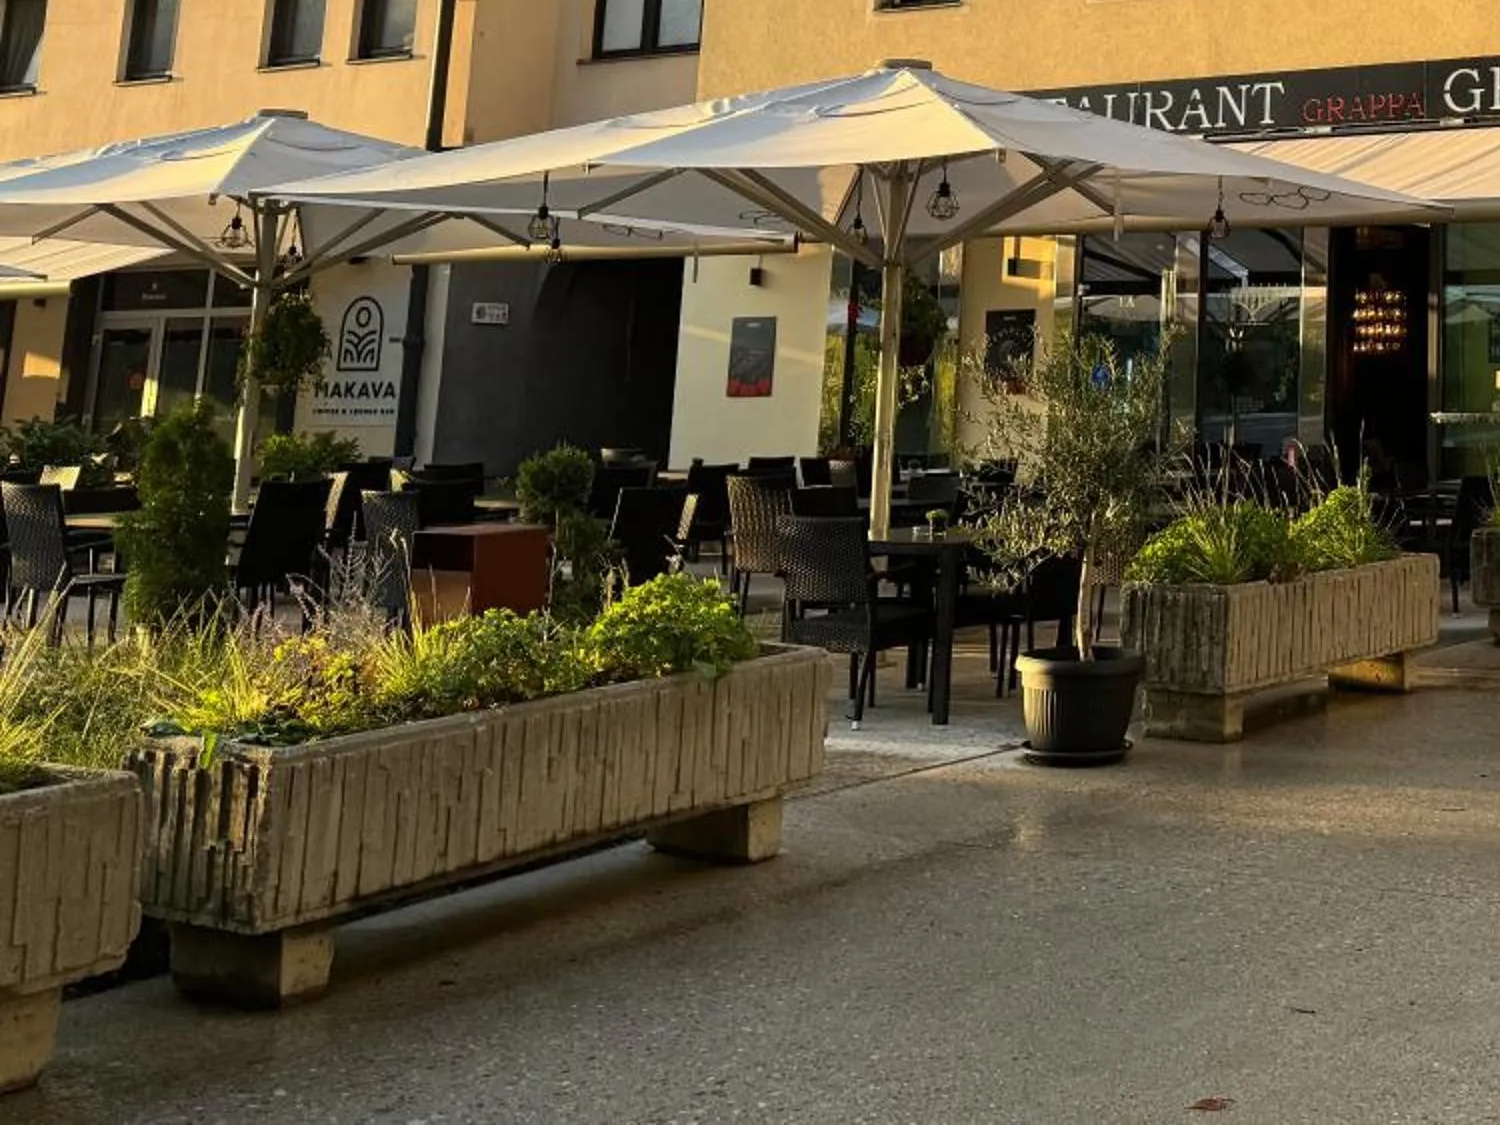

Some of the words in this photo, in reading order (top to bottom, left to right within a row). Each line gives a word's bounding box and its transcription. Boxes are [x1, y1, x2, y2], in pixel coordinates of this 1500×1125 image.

[1049, 82, 1285, 132] URANT
[1302, 91, 1426, 124] GRAPPA
[313, 380, 397, 399] MAKAVA
